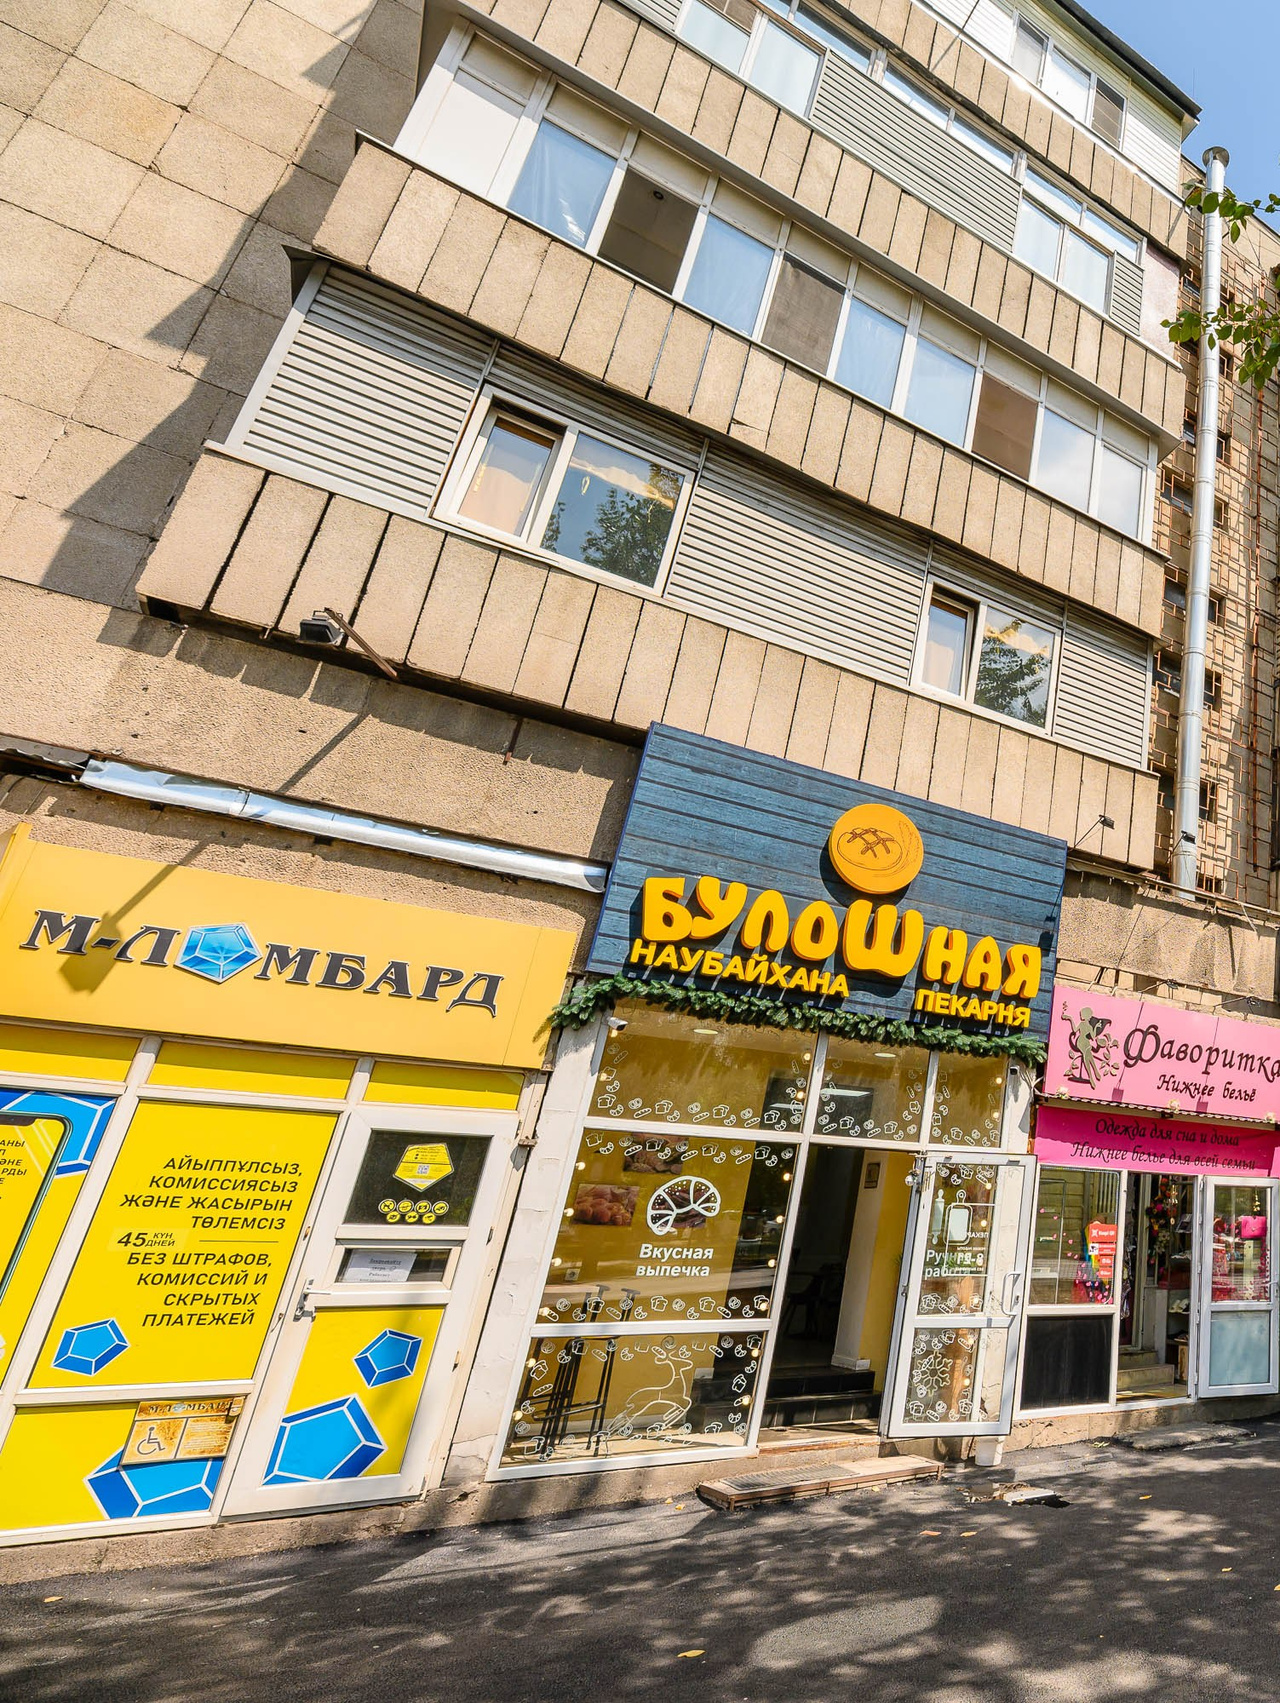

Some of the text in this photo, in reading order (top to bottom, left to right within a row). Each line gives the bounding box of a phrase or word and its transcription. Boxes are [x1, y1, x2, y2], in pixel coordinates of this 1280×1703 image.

[641, 876, 1042, 999] БУЛОШНАЯ
[629, 938, 850, 999] НАУБАЙХАНА
[914, 987, 1032, 1029] ПЕКАРНЯ
[1156, 1074, 1215, 1099] Нижнее
[1095, 1118, 1240, 1146] Одежда для сна и дома
[1070, 1141, 1256, 1171] Нижнее белье для всей семьи
[163, 1155, 302, 1177] АЙЫППҰЛСЫЗ,
[149, 1175, 298, 1193] КОМИССИЯСЫЗ
[120, 1194, 293, 1212] ЖӘНЕ ЖАСЫРЫН
[191, 1216, 286, 1230] ТӨЛЕМСІЗ
[117, 1232, 148, 1247] 45
[145, 1239, 175, 1247] ДНЕЙ
[127, 1252, 272, 1268] БЕЗ ШТРАФОВ,
[639, 1243, 714, 1263] Вкусная
[137, 1270, 268, 1286] КОМИССИЙ И
[635, 1265, 710, 1277] выпечка
[163, 1292, 261, 1306] СКРЫТЫХ
[142, 1309, 255, 1327] ПЛАТЕЖЕЙ
